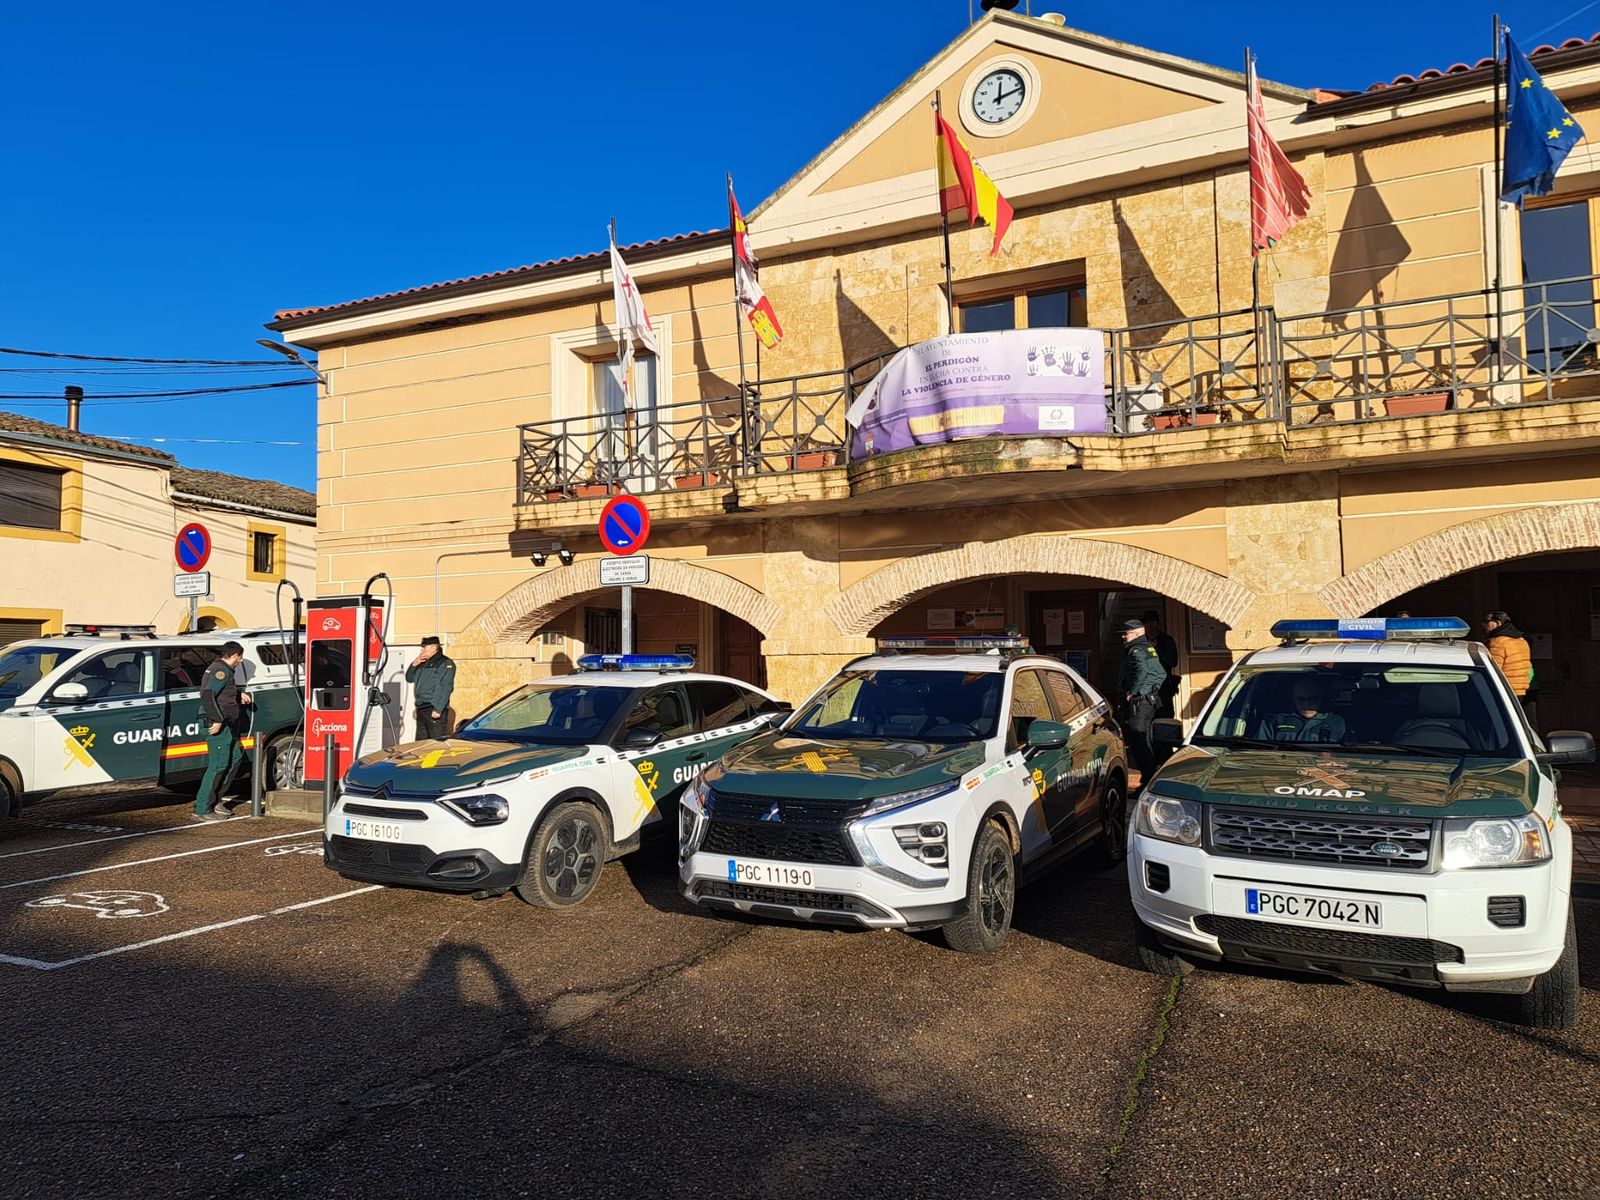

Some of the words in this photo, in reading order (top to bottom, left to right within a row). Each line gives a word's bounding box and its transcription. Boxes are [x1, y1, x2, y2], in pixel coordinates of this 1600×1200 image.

[925, 364, 933, 372] EL
[933, 355, 980, 370] PERDIGÓN
[952, 365, 989, 375] CONTRA
[914, 378, 953, 394] VIOLENCIA
[955, 376, 968, 384] DE
[970, 373, 1011, 382] GÉNERO
[113, 724, 182, 745] GUARIA
[320, 722, 347, 732] acciona
[1274, 786, 1366, 799] OMAP
[1315, 801, 1412, 816] ROVER
[351, 821, 368, 836] PGC
[370, 824, 393, 839] 1610
[393, 826, 400, 840] G
[736, 864, 762, 881] PGC
[766, 867, 799, 885] 1119
[1259, 893, 1299, 916] PGC
[1304, 898, 1360, 923] 7042
[1365, 904, 1379, 925] N
